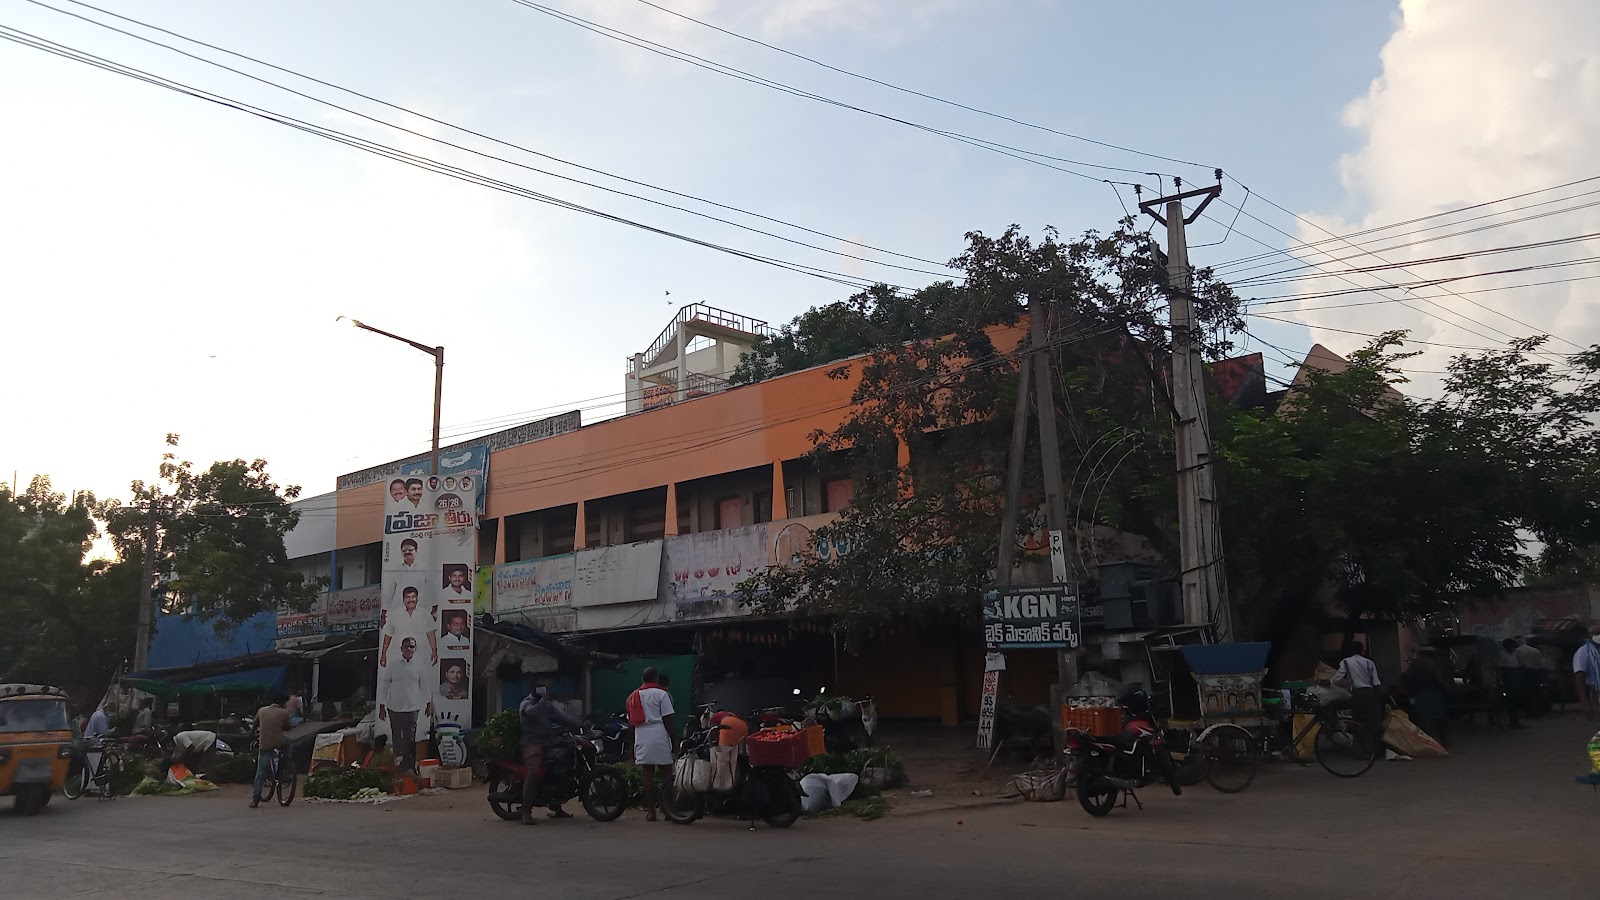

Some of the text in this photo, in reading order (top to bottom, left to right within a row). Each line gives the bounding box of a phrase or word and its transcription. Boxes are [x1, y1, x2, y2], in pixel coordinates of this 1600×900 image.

[385, 508, 474, 534] ప్రజా తీర్పు
[1003, 594, 1057, 618] KGN
[985, 623, 1004, 648] బైక్
[1005, 621, 1051, 642] మెకానిక్
[981, 719, 992, 732] 44
